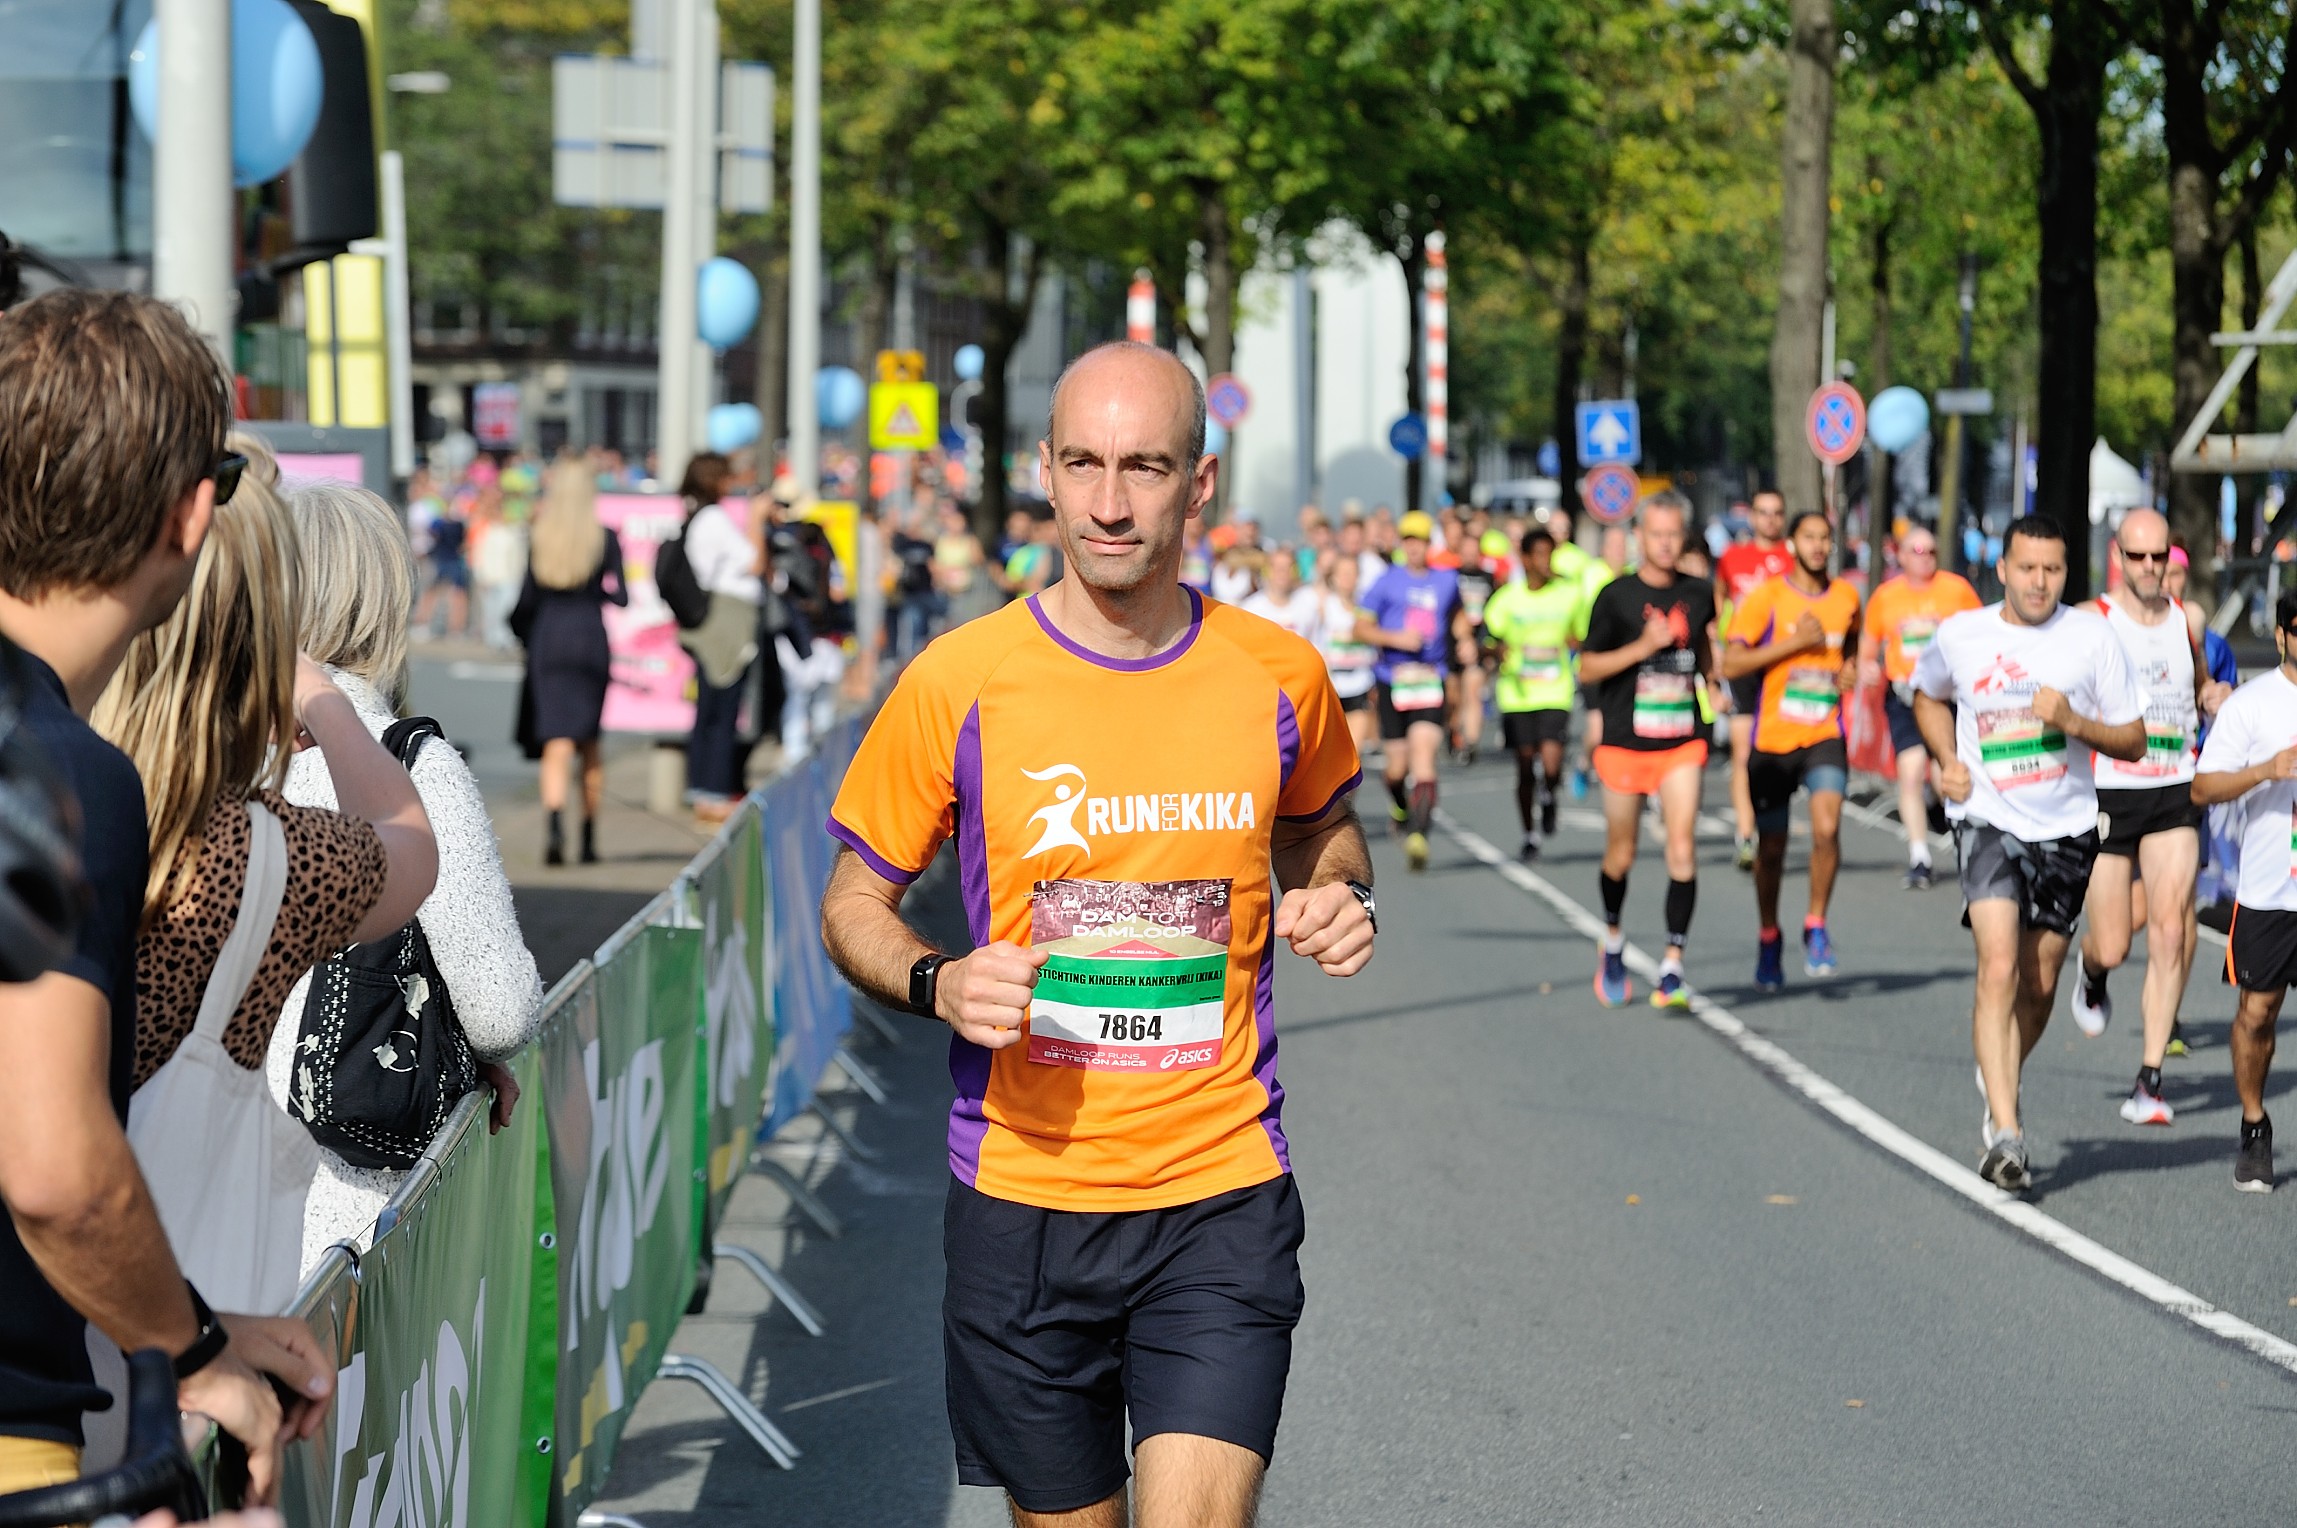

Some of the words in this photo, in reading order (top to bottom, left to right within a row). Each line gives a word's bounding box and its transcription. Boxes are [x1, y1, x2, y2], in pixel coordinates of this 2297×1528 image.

[1087, 794, 1160, 836] RUN
[1161, 793, 1180, 831] FOR
[1181, 792, 1256, 831] KIKA
[1081, 911, 1137, 923] DAM
[1142, 911, 1189, 924] TOT
[1072, 924, 1197, 939] DAMLOOP
[1037, 968, 1087, 985] STICHTING
[1088, 974, 1136, 987] KINDEREN
[1138, 973, 1194, 987] KANKERVRIJ
[1099, 1014, 1162, 1041] 7864
[1044, 1051, 1090, 1064] BETTER
[1091, 1058, 1111, 1066] ON
[1111, 1059, 1147, 1067] ASICS
[1051, 1045, 1106, 1058] DAMLOOP
[1108, 1052, 1140, 1060] RUNS
